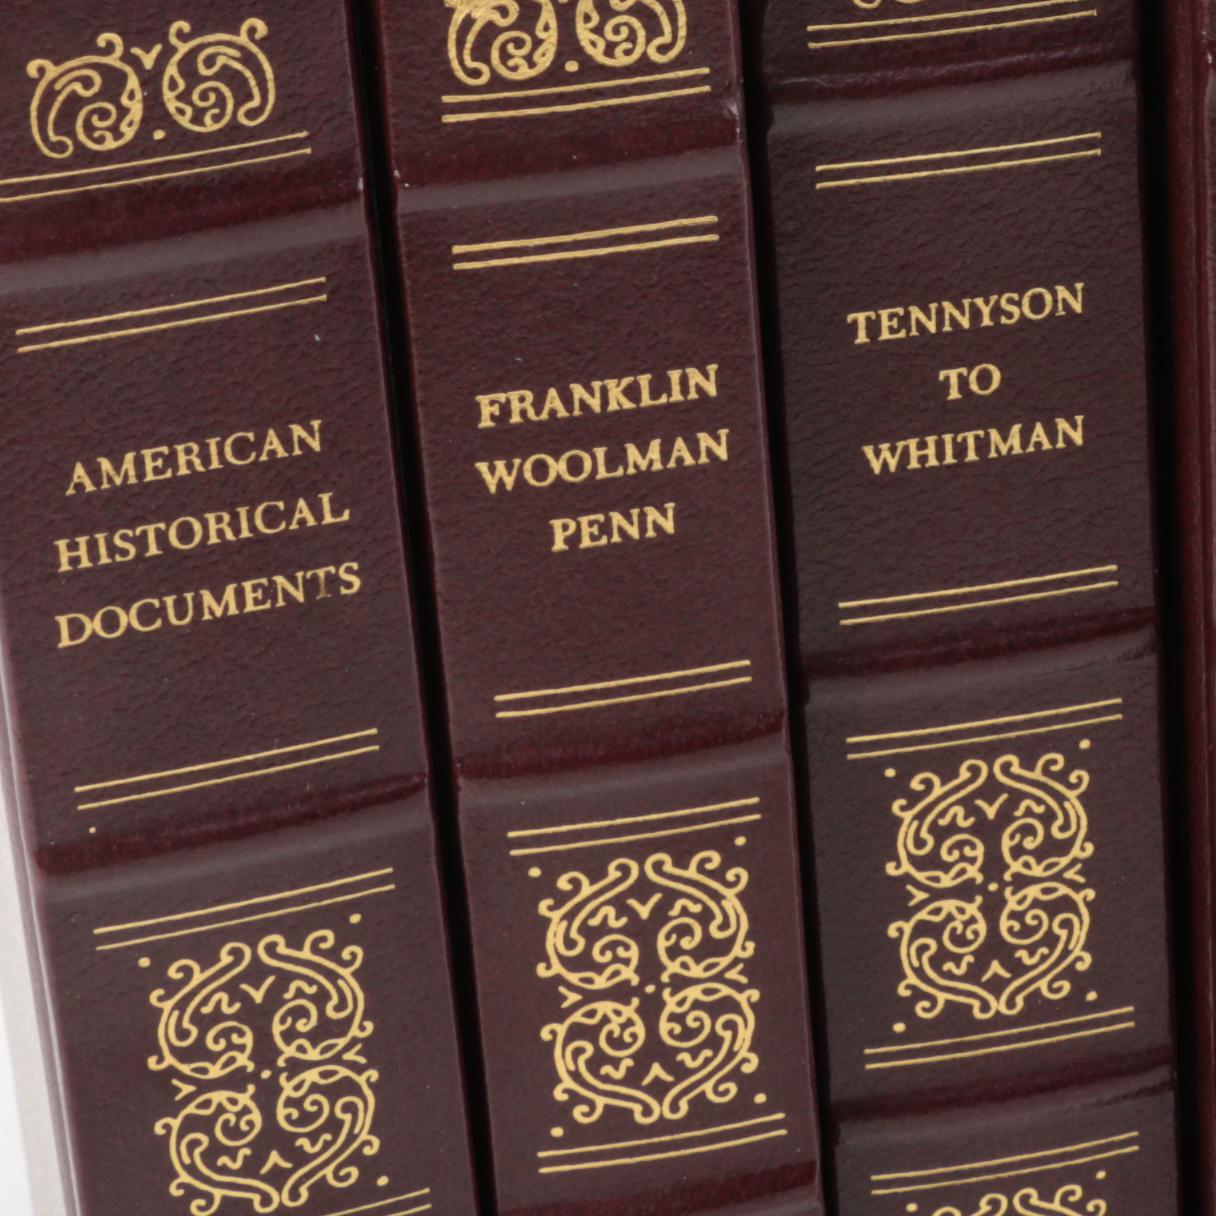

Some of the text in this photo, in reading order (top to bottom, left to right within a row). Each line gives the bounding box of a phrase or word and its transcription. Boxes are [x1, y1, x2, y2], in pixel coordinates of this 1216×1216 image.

[846, 282, 1085, 345] TENNYSON
[474, 363, 719, 429] FRANKLIN
[938, 362, 1002, 401] TO
[66, 419, 323, 497] AMERICAN
[474, 428, 730, 495] WOOLMAN
[861, 414, 1085, 475] WHITMAN
[53, 491, 351, 573] HISTORICAL
[548, 501, 676, 553] PENN
[53, 561, 362, 649] DOCUMENTS
